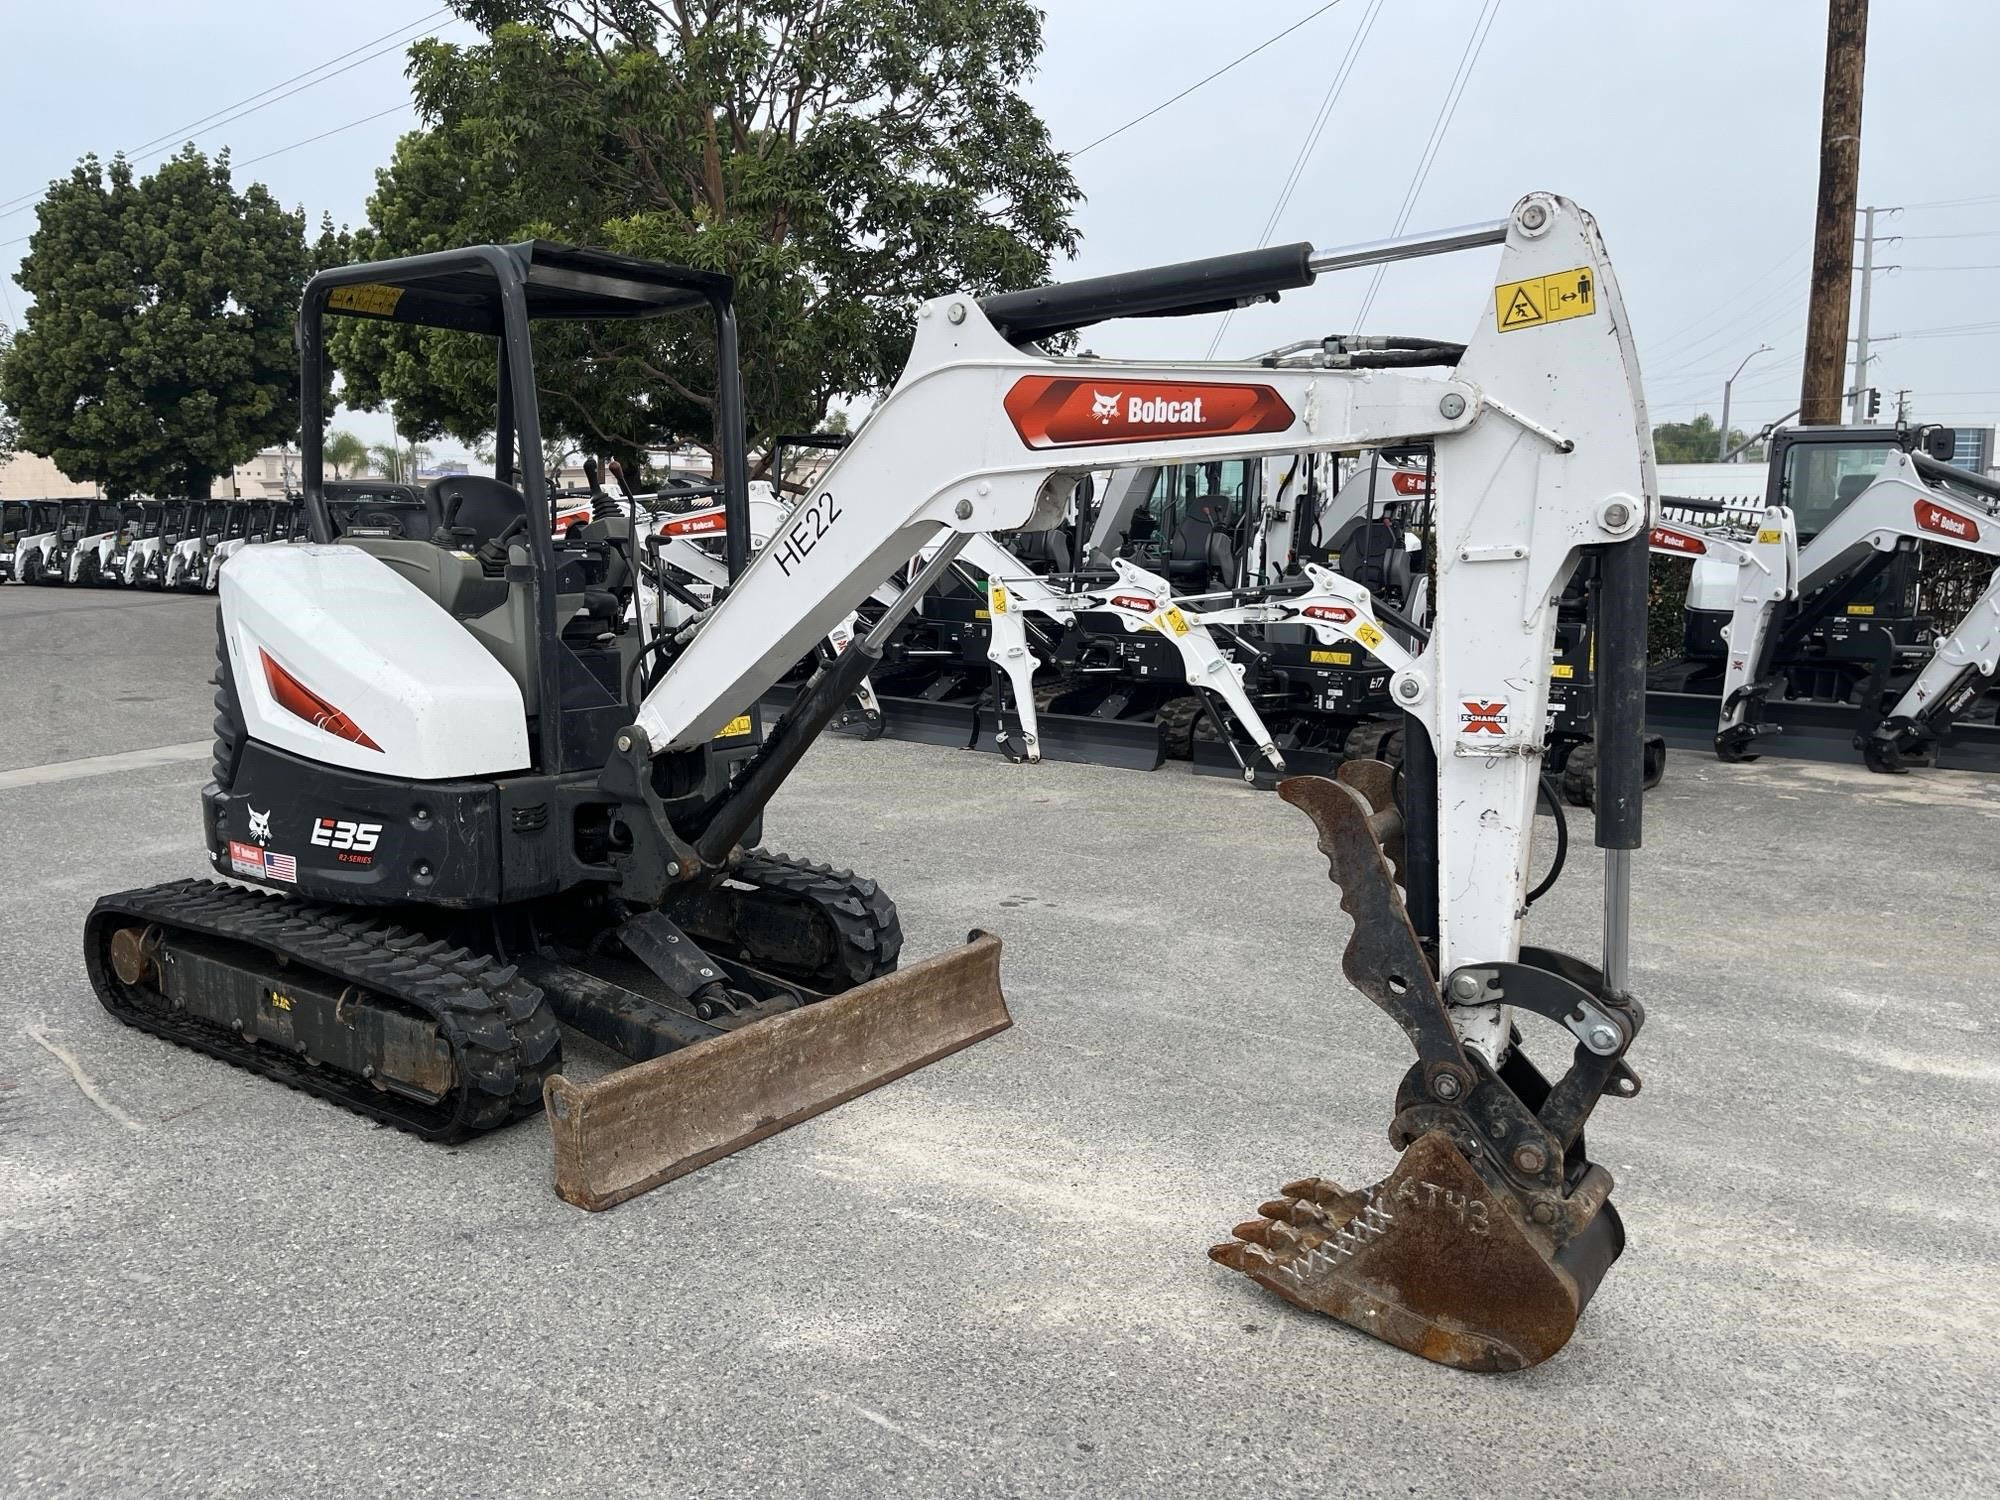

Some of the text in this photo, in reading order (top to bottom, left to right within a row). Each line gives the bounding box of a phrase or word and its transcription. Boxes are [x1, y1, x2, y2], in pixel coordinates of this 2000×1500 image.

[1127, 397, 1203, 424] Bobcat
[692, 520, 715, 531] Bobcat
[773, 492, 842, 577] HE22
[1369, 676, 1385, 689] E17
[1461, 714, 1507, 723] X-CHANGE
[310, 817, 383, 852] E35
[338, 854, 374, 864] R2-SERIES
